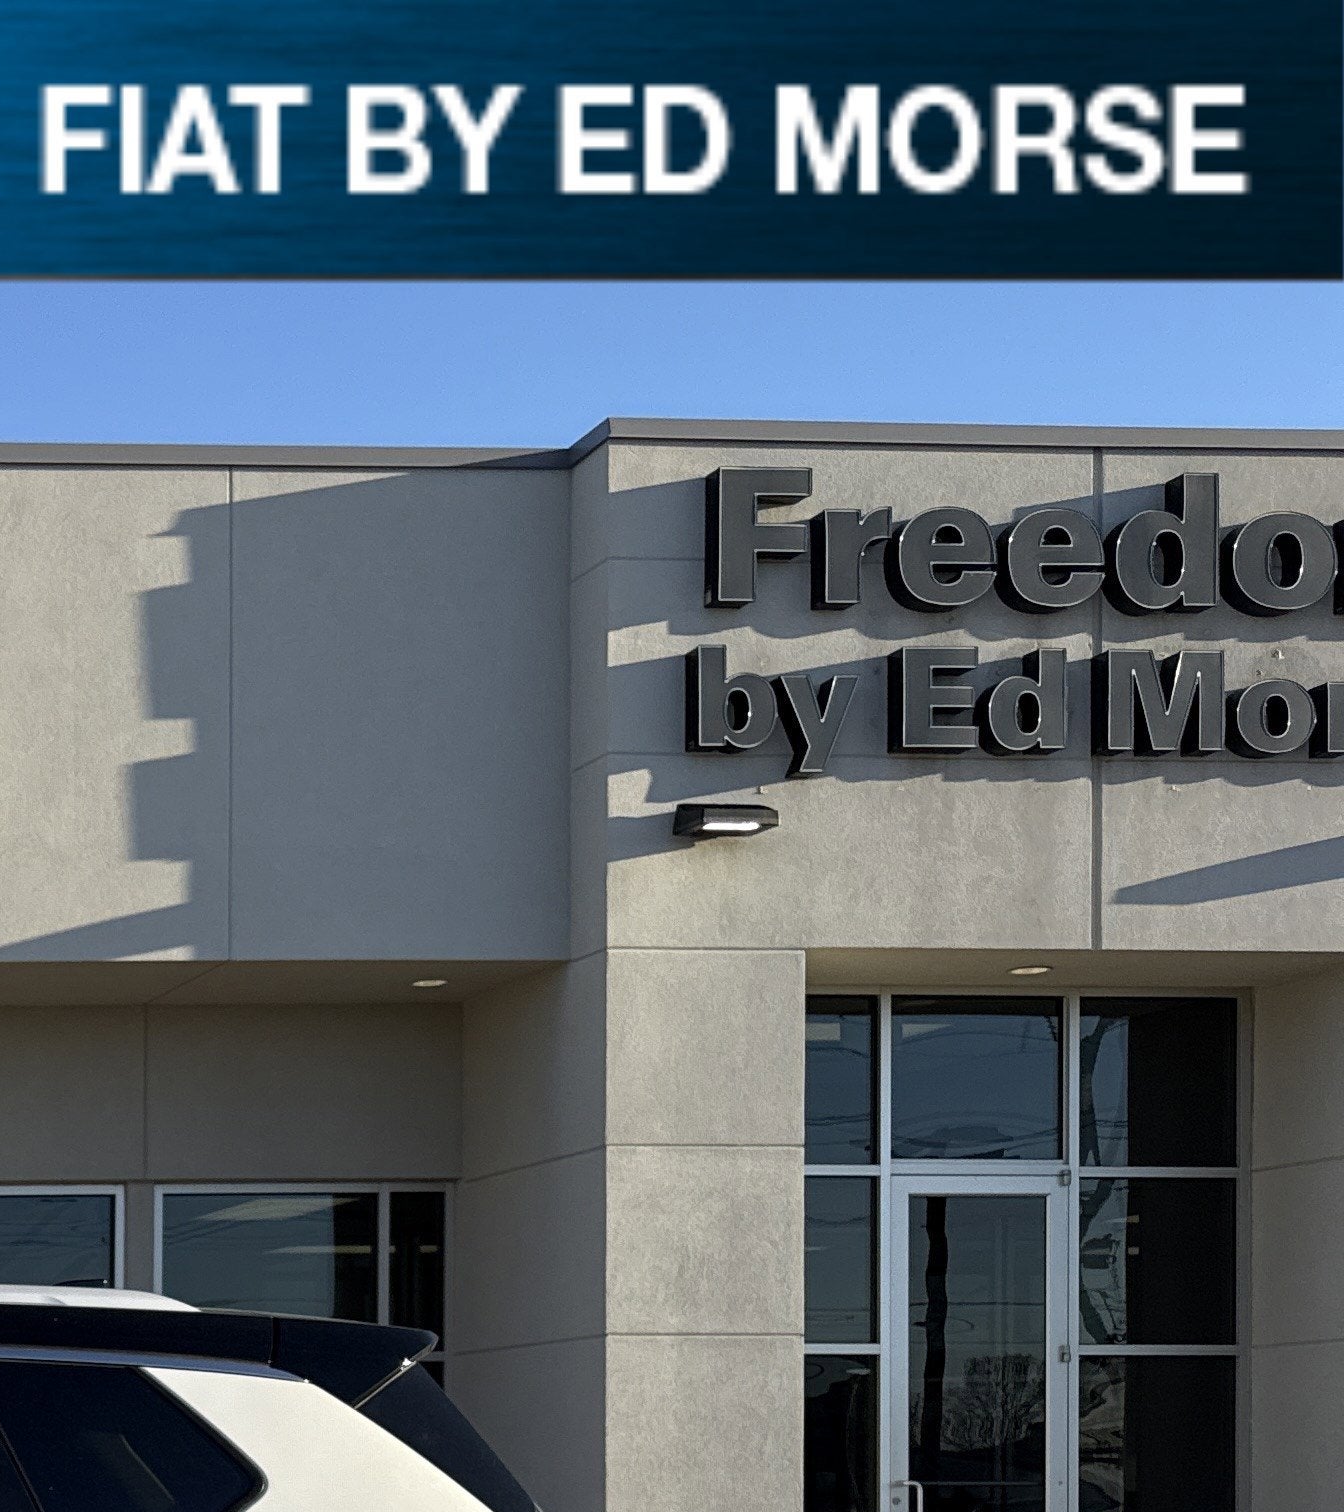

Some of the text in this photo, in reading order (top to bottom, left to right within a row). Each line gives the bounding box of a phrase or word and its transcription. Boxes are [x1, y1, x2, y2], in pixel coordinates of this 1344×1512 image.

[706, 466, 1344, 610] Freedo
[688, 643, 860, 776] by
[890, 645, 1068, 752] Ed
